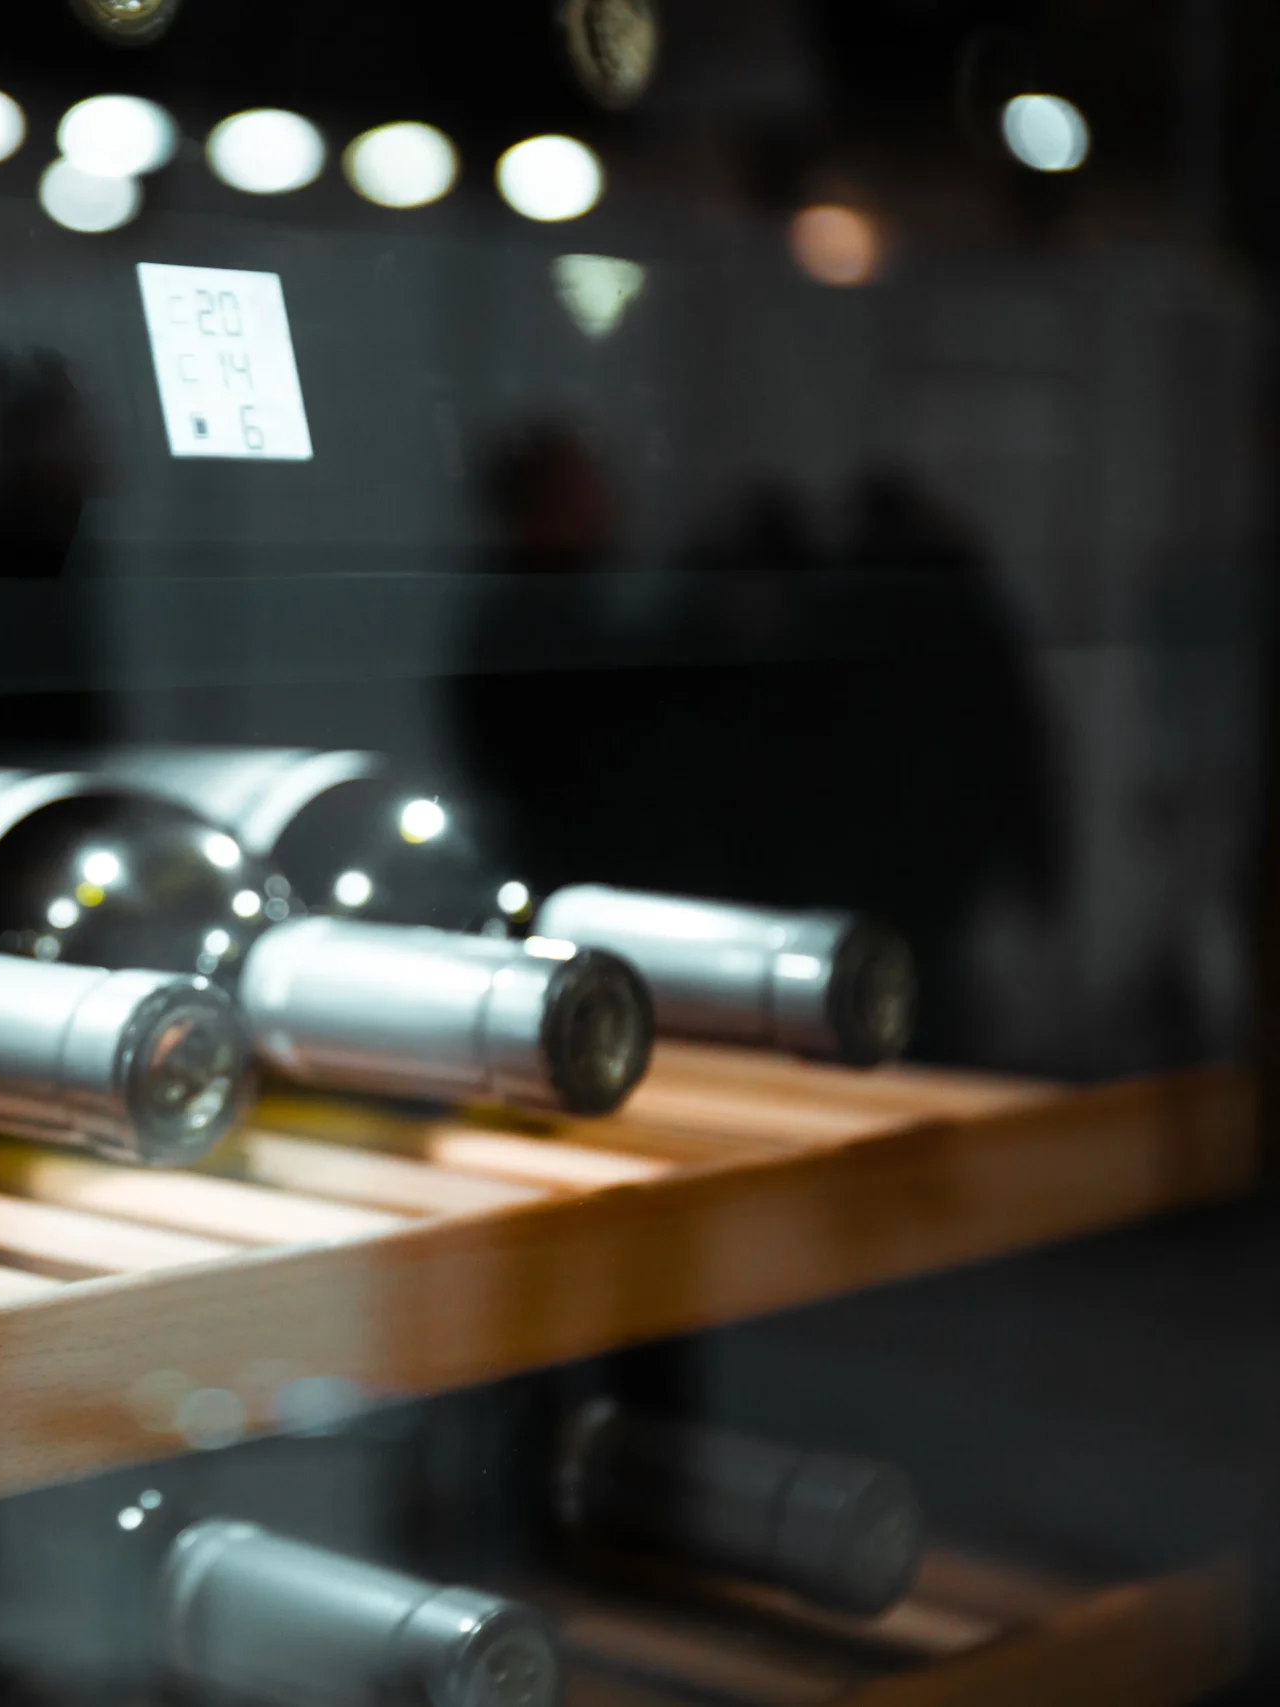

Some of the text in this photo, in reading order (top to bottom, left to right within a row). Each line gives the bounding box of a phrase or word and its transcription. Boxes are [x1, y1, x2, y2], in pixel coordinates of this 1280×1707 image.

[194, 288, 243, 337] 20
[218, 350, 255, 391] 14
[239, 403, 265, 451] 6
